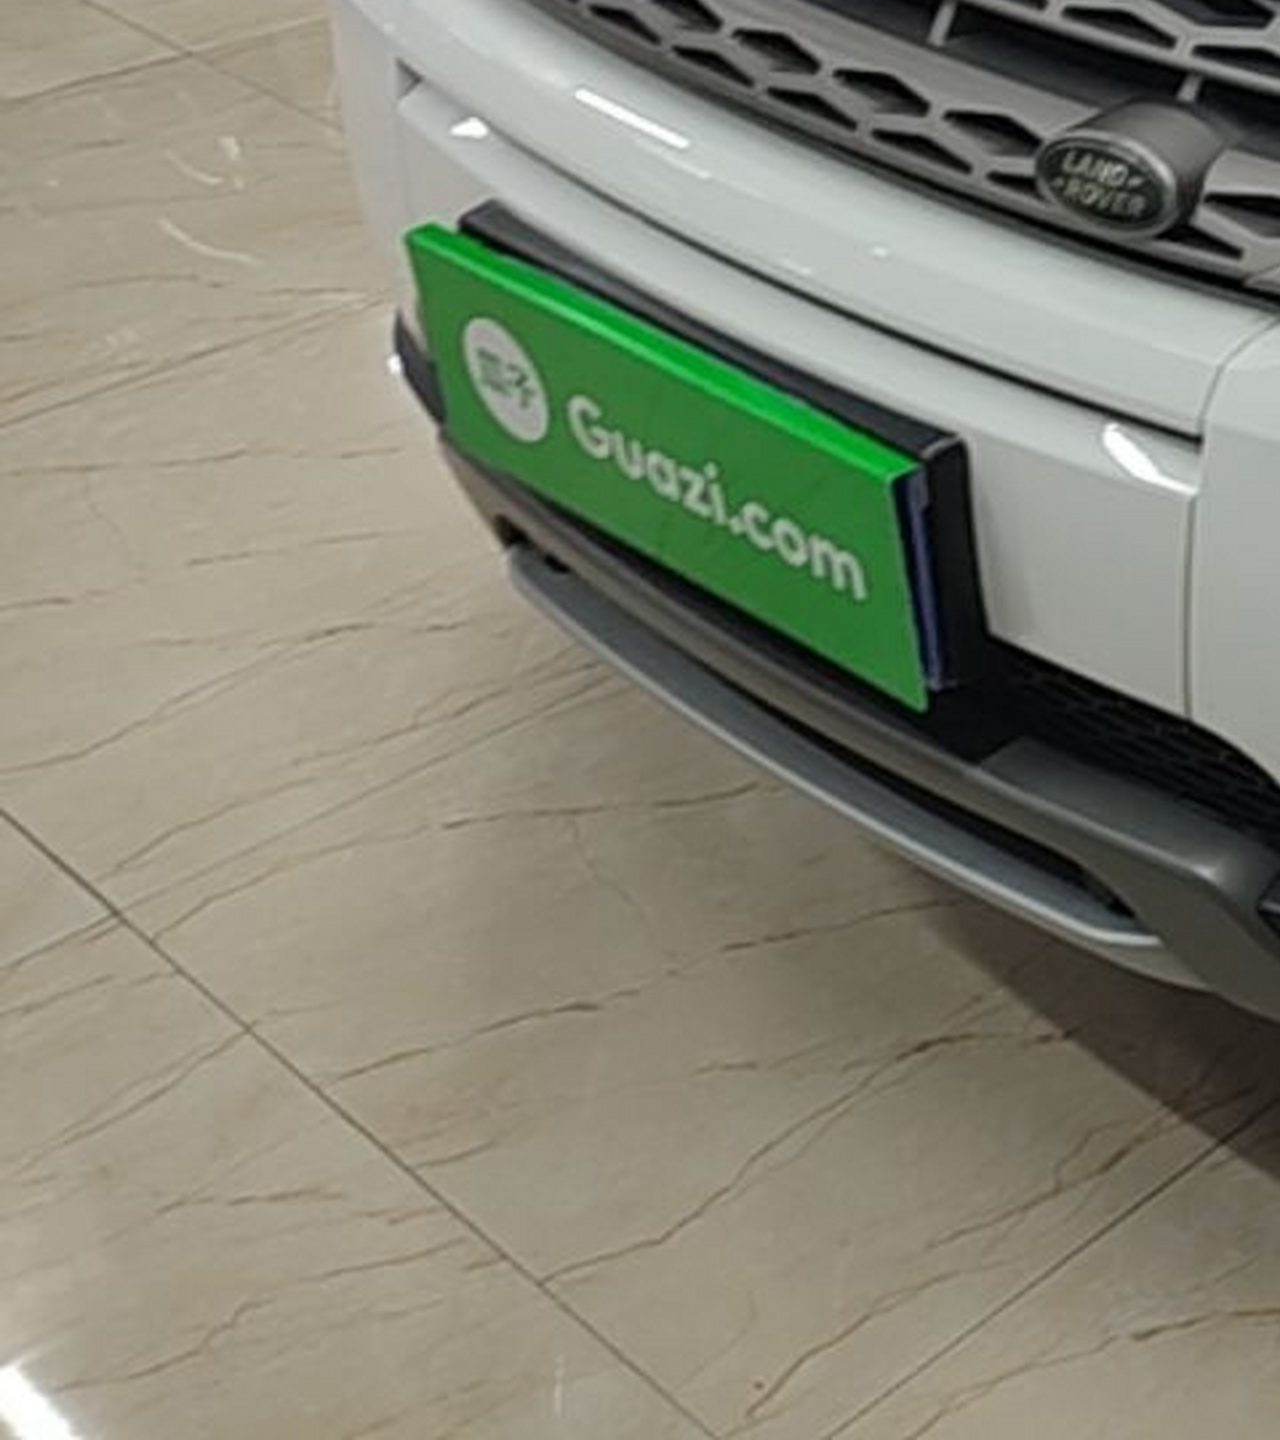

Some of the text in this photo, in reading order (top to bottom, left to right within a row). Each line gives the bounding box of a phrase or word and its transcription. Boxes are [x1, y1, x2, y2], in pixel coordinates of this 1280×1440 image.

[1060, 148, 1130, 187] LAND
[1062, 176, 1147, 219] ROVER
[565, 394, 867, 602] Guazi.com
